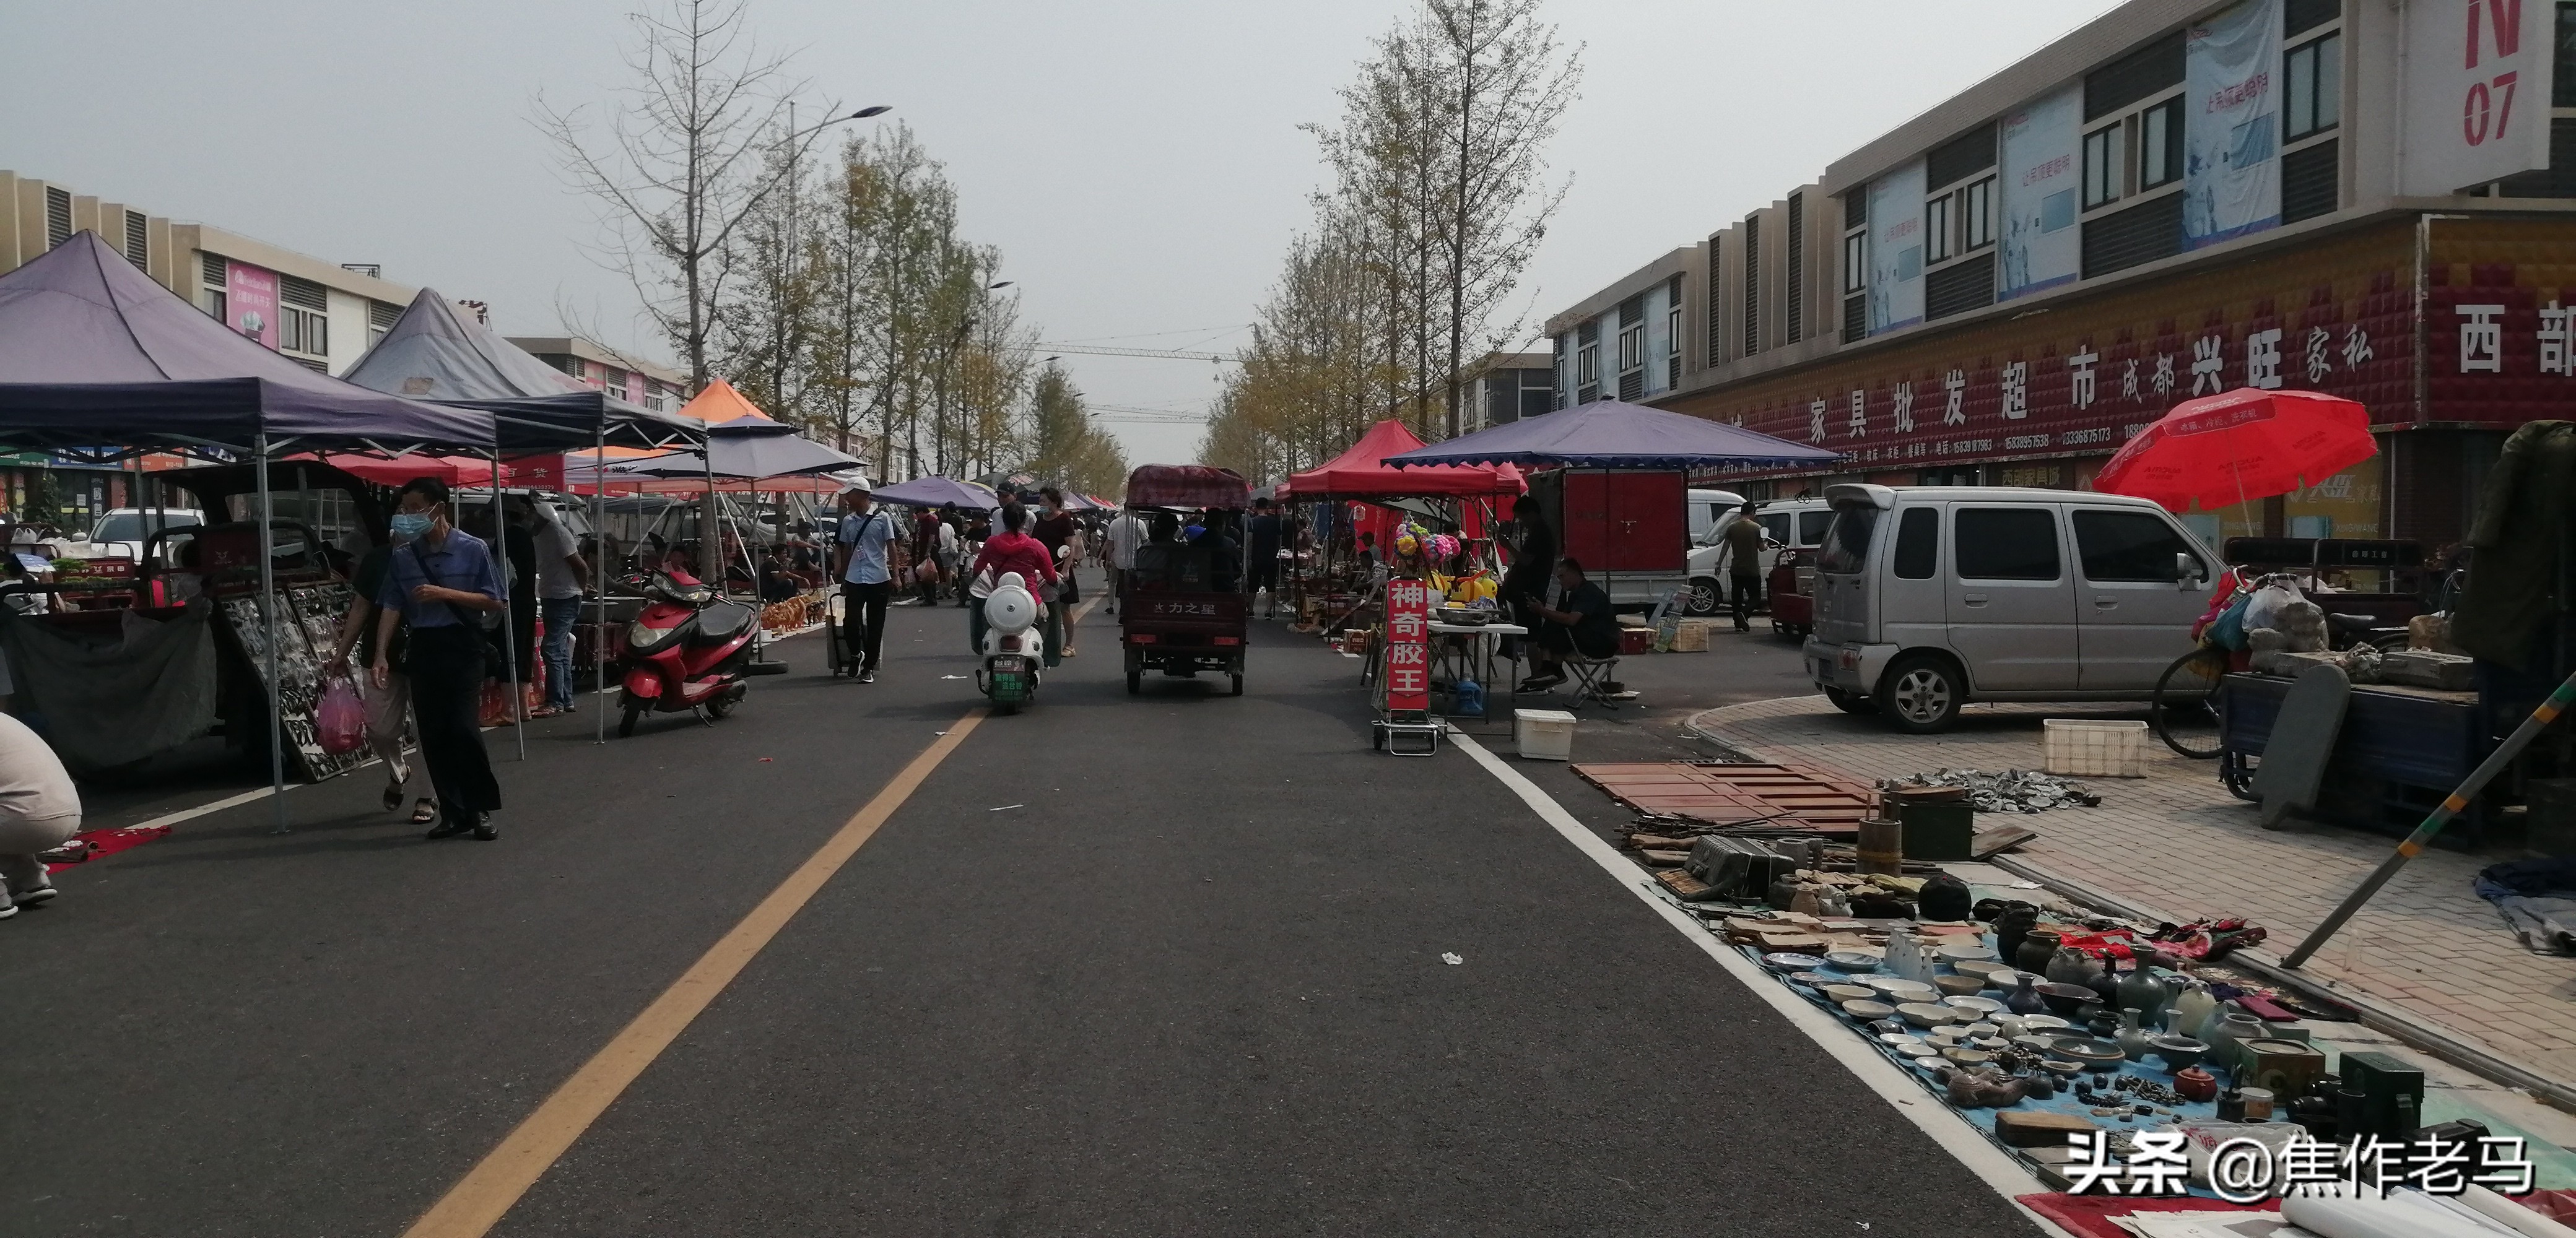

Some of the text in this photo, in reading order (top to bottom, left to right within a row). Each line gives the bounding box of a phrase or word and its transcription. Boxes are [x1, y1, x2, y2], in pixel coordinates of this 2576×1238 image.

[2465, 71, 2517, 147] 07
[1391, 582, 1425, 693] 神奇胶王
